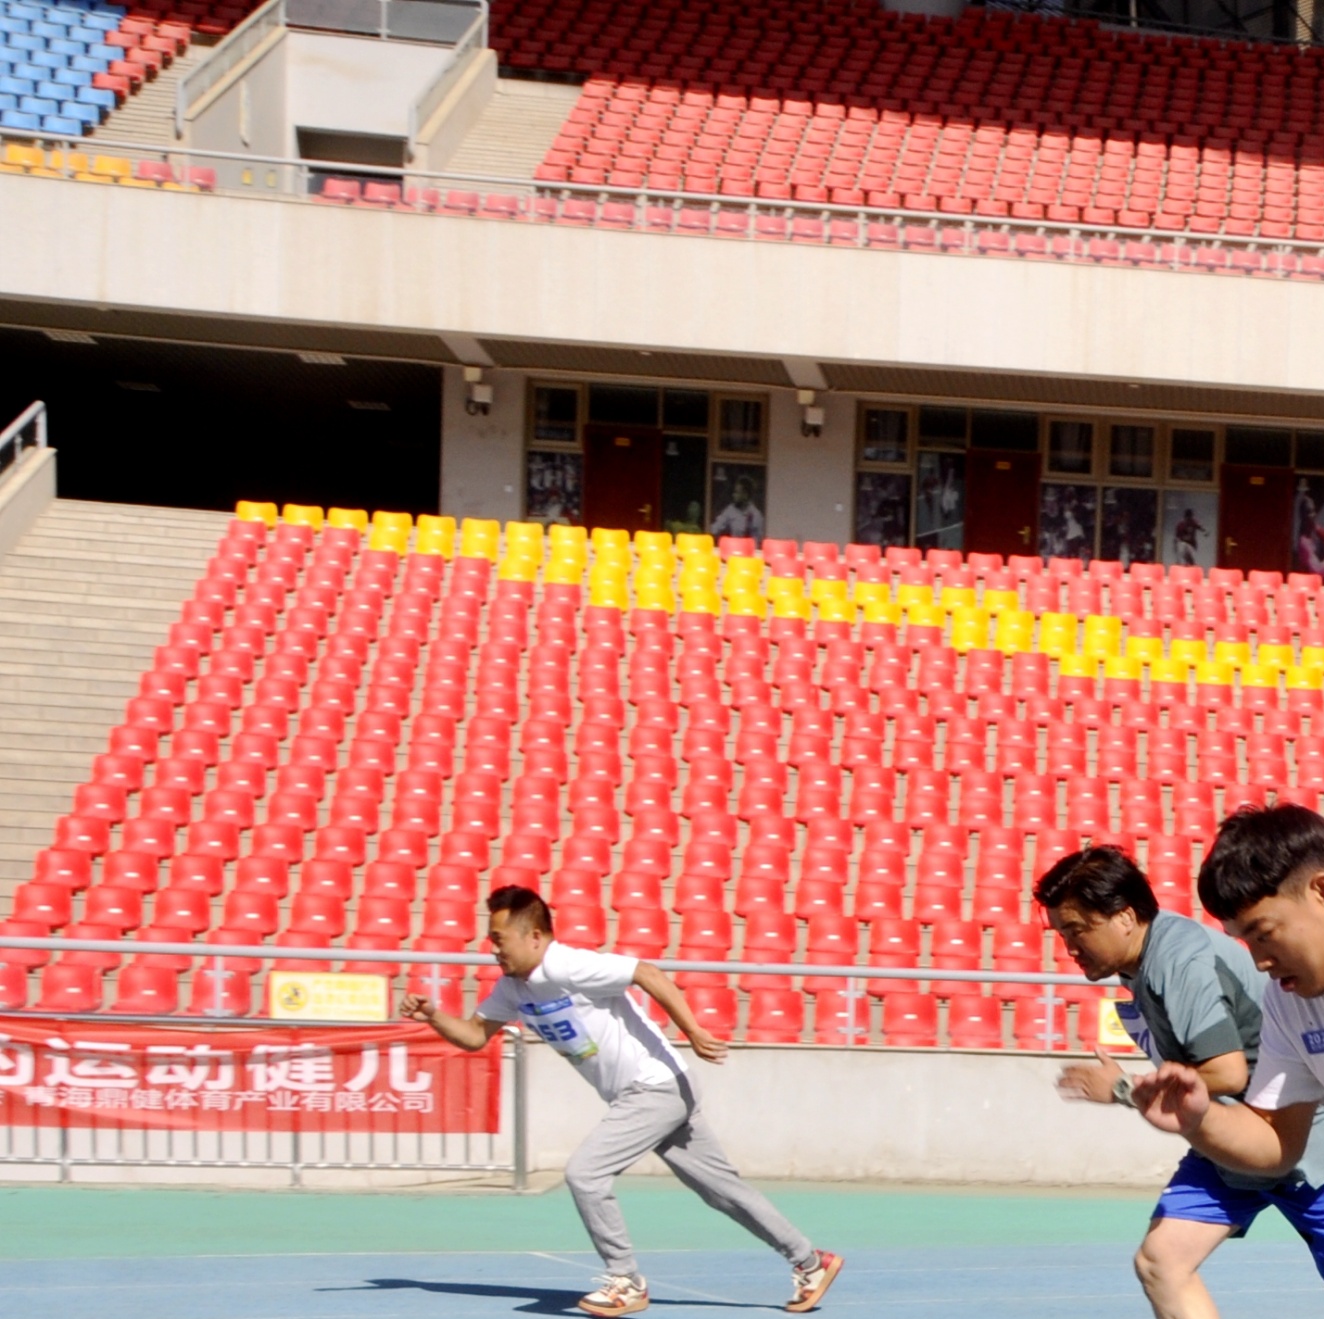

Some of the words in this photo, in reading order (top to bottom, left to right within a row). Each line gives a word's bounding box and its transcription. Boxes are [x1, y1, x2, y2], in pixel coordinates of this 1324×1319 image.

[24, 1086, 434, 1114] 青海鼎健体育产业有限公司
